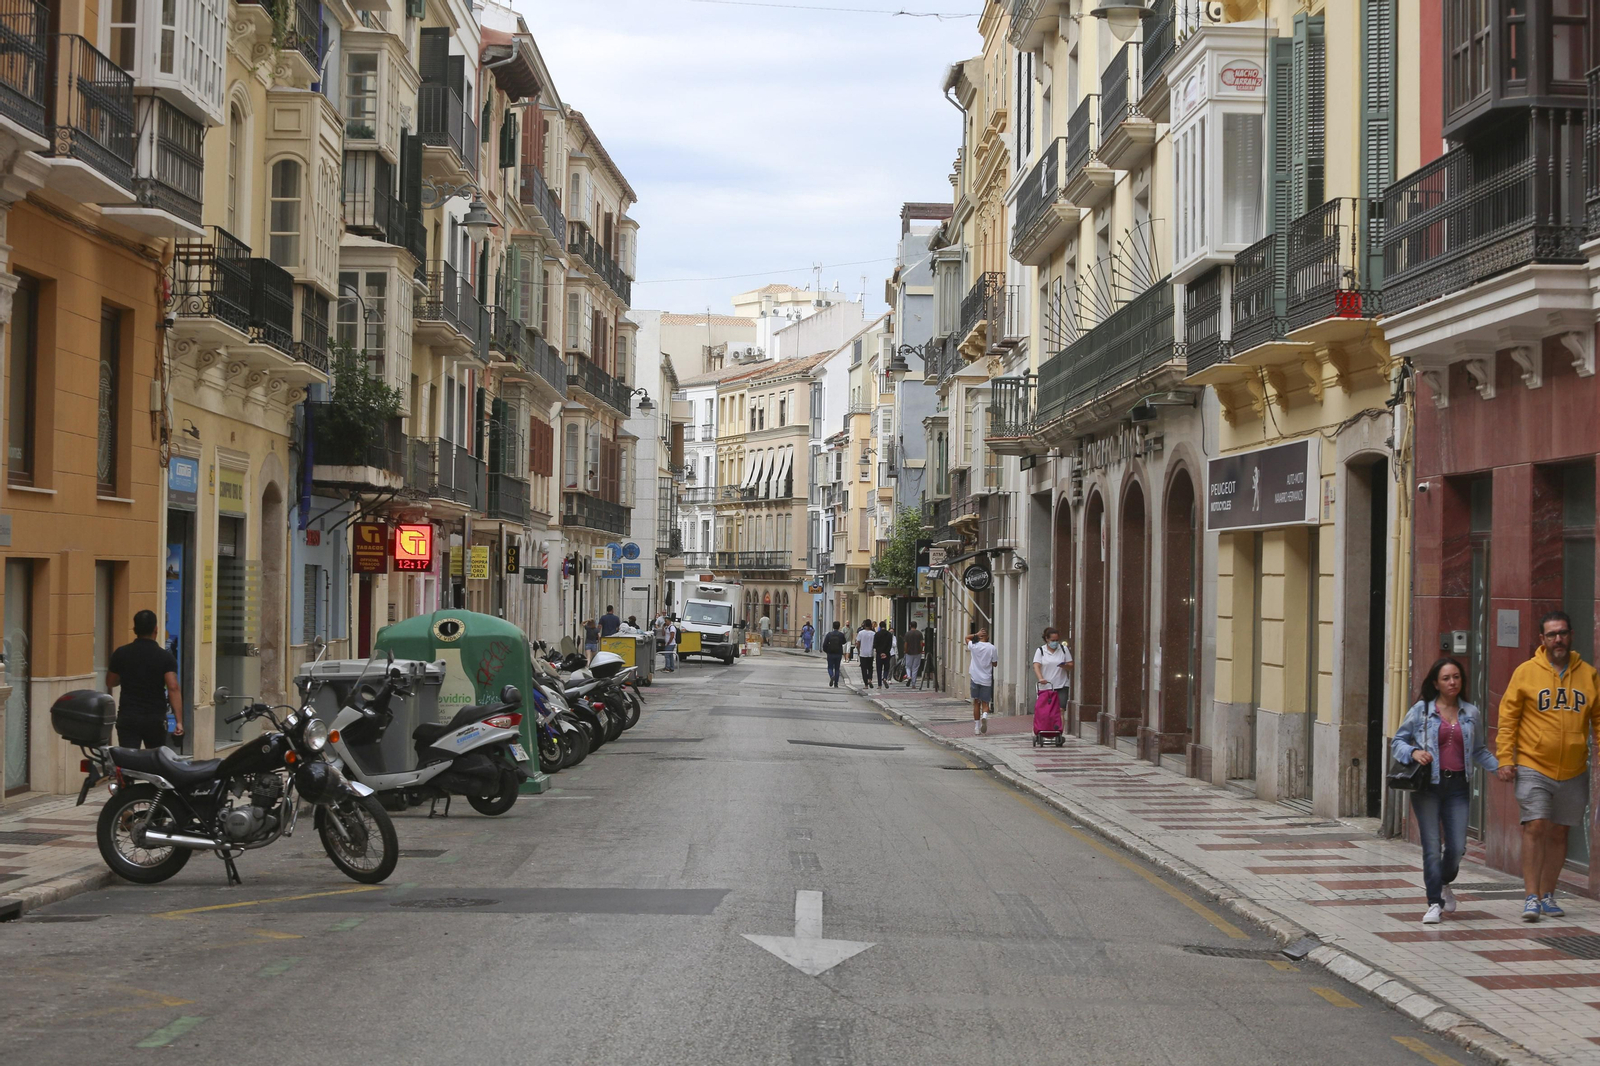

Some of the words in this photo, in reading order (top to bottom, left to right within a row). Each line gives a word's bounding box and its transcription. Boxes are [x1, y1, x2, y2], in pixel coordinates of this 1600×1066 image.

[1235, 69, 1258, 78] NACHO
[1210, 481, 1236, 496] PEUGEOT
[1210, 500, 1232, 512] MOTOCYCLES
[398, 560, 429, 569] 12:17
[1538, 687, 1586, 712] GAP
